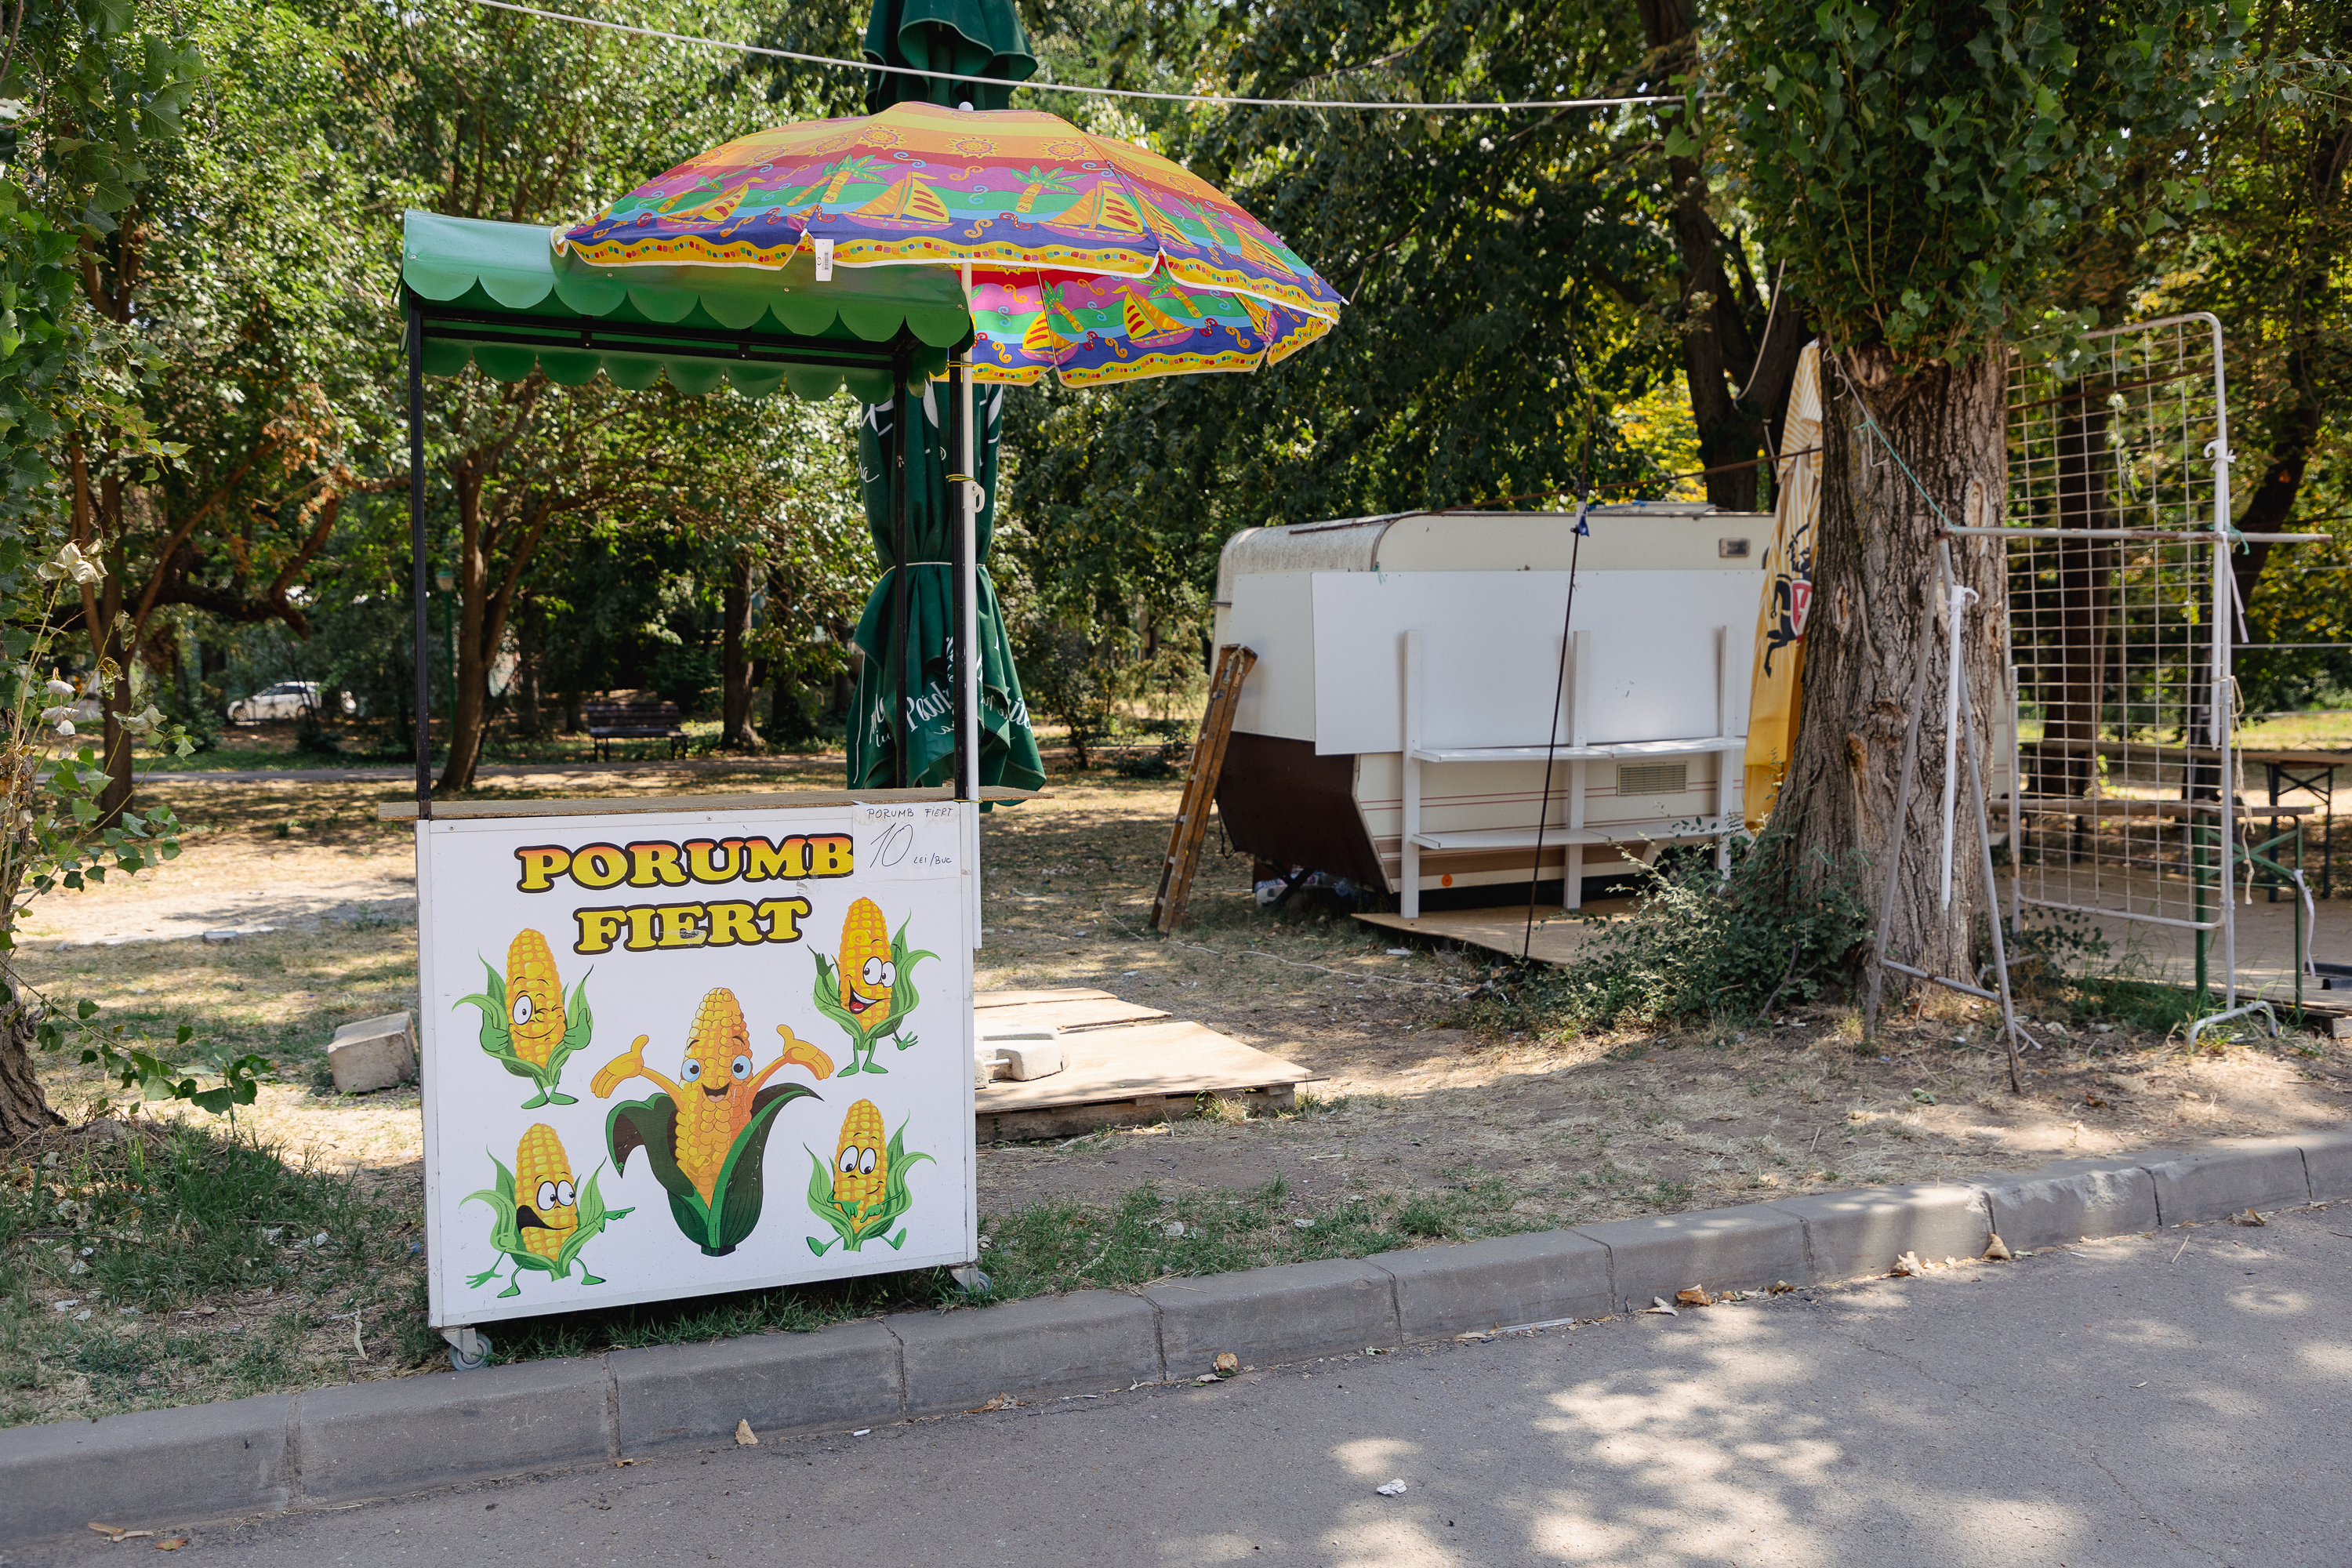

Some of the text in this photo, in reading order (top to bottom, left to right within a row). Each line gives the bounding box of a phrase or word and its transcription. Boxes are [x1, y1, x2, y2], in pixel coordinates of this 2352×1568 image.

[866, 808, 914, 819] PORUMB
[514, 833, 854, 893] PORUMB
[869, 822, 913, 868] 10
[572, 896, 813, 955] FIERT
